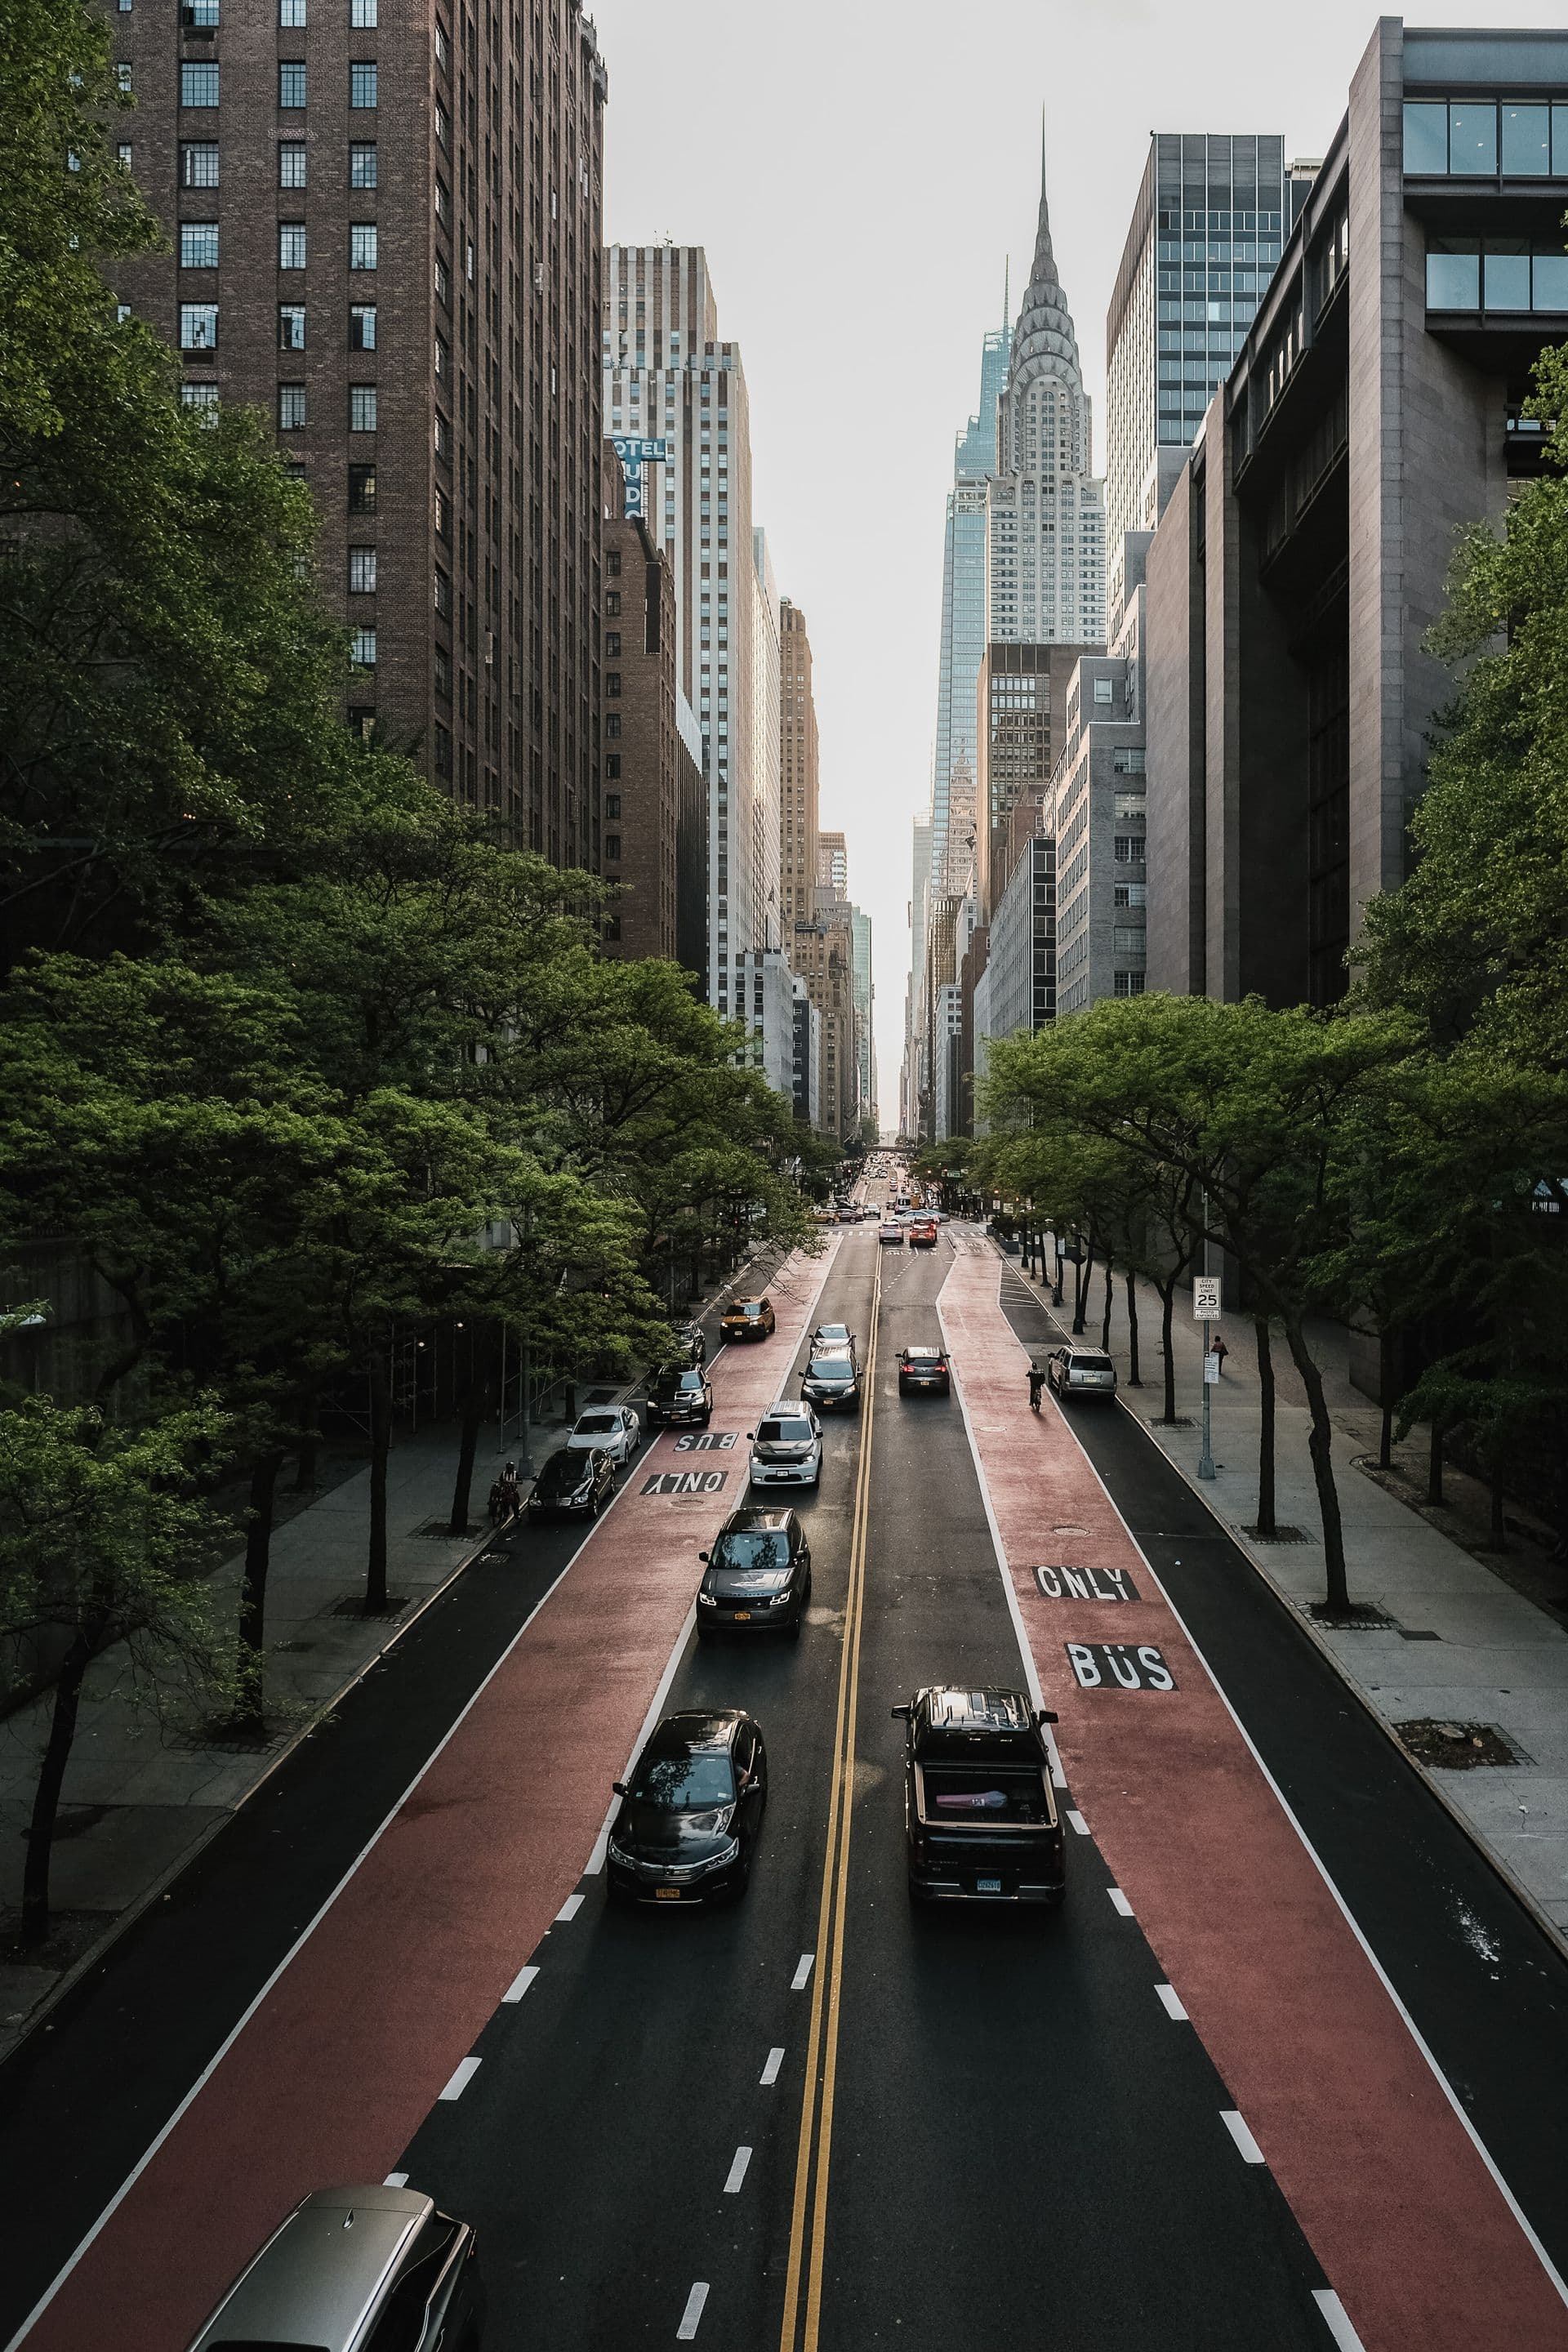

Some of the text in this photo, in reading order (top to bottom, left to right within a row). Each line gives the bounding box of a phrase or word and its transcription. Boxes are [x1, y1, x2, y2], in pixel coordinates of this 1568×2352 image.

[1198, 1294, 1217, 1306] 25
[675, 1432, 739, 1451] BUS
[645, 1472, 723, 1494] ONLY
[1037, 1566, 1129, 1601] ONLY
[1067, 1643, 1174, 1690] BUS
